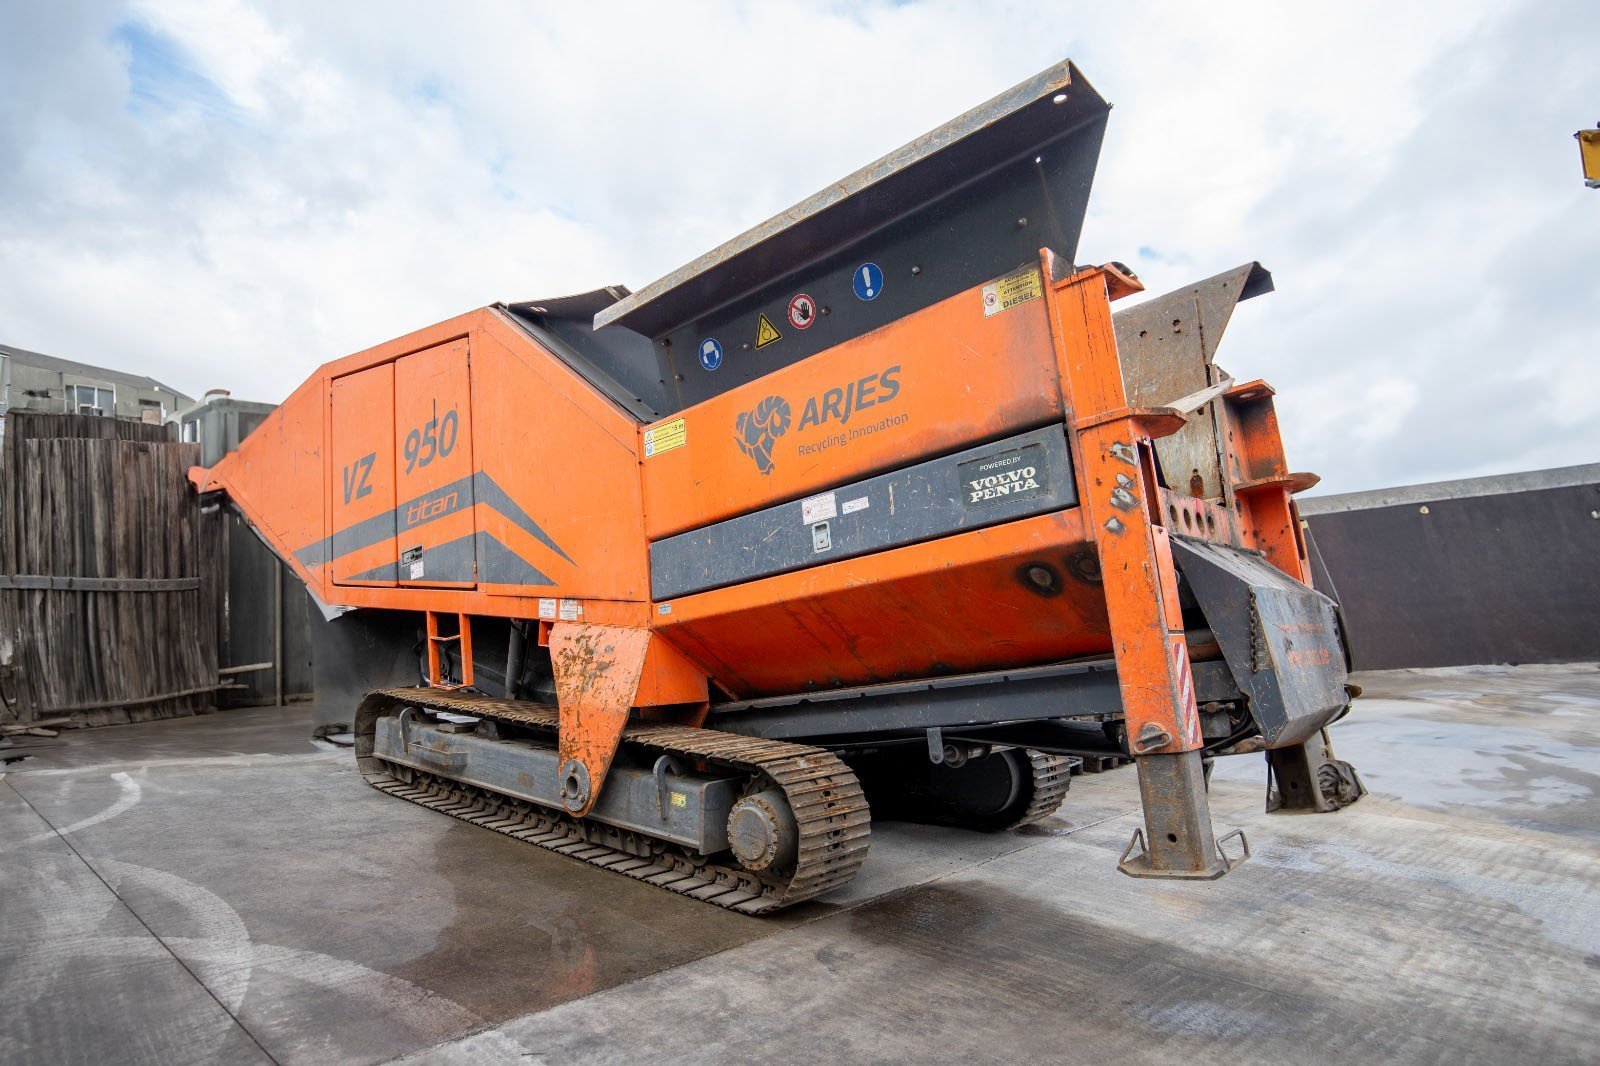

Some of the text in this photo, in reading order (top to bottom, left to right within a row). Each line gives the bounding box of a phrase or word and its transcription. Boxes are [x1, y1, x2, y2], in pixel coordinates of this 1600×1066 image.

[1003, 281, 1033, 295] ATTENTION
[1003, 291, 1035, 308] DIESEL
[797, 365, 901, 432] ARJES
[798, 413, 909, 457] Recycling Innovation
[343, 409, 458, 505] VZ 950
[979, 455, 1022, 471] POWERED BY
[969, 466, 1036, 491] VOLVO
[970, 478, 1040, 503] PENTA
[407, 492, 458, 525] titan
